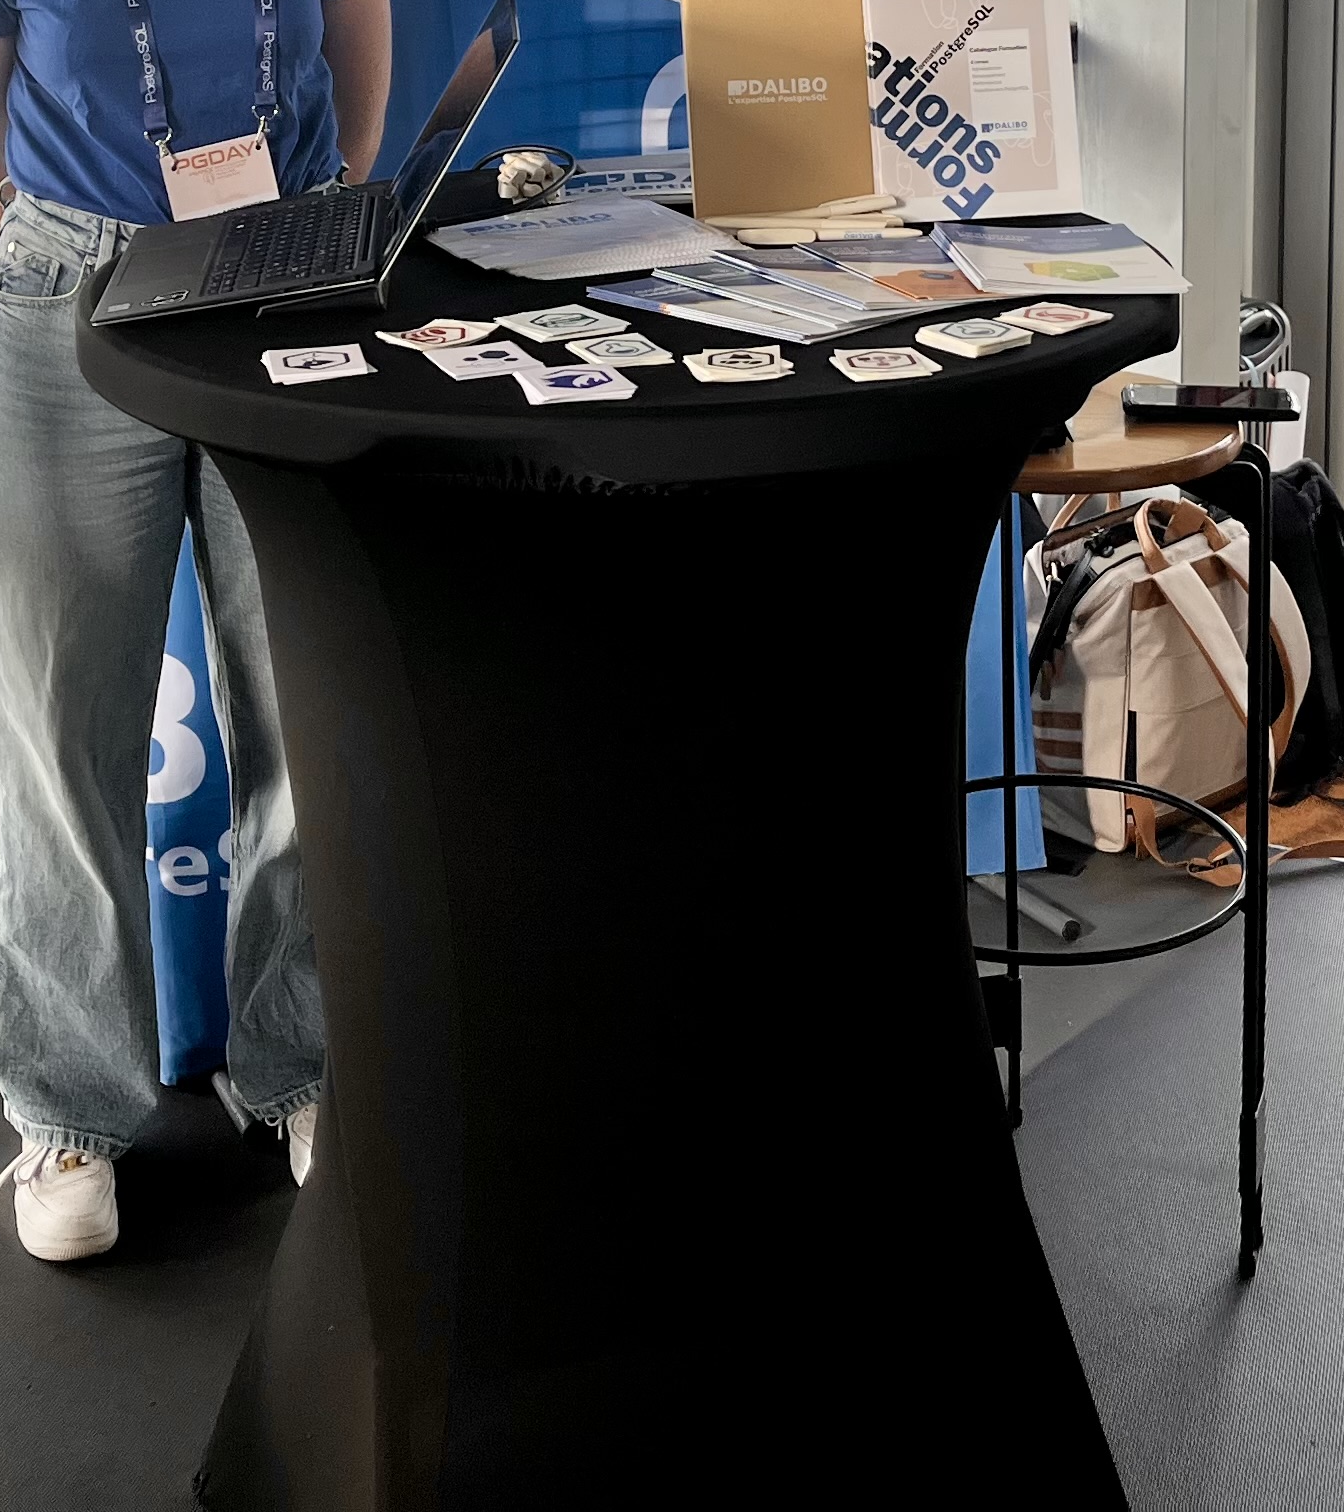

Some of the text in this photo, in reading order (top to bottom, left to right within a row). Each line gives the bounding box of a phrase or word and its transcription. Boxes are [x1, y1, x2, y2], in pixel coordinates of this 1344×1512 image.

[931, 4, 995, 74] PostgreSQL
[135, 22, 156, 104] PostgreSQL
[913, 40, 945, 74] Formation
[728, 93, 828, 105] L'expertise PostgreSQL
[748, 76, 828, 95] DALIBO
[994, 120, 1028, 129] DALIBO
[175, 140, 255, 175] PGDAY
